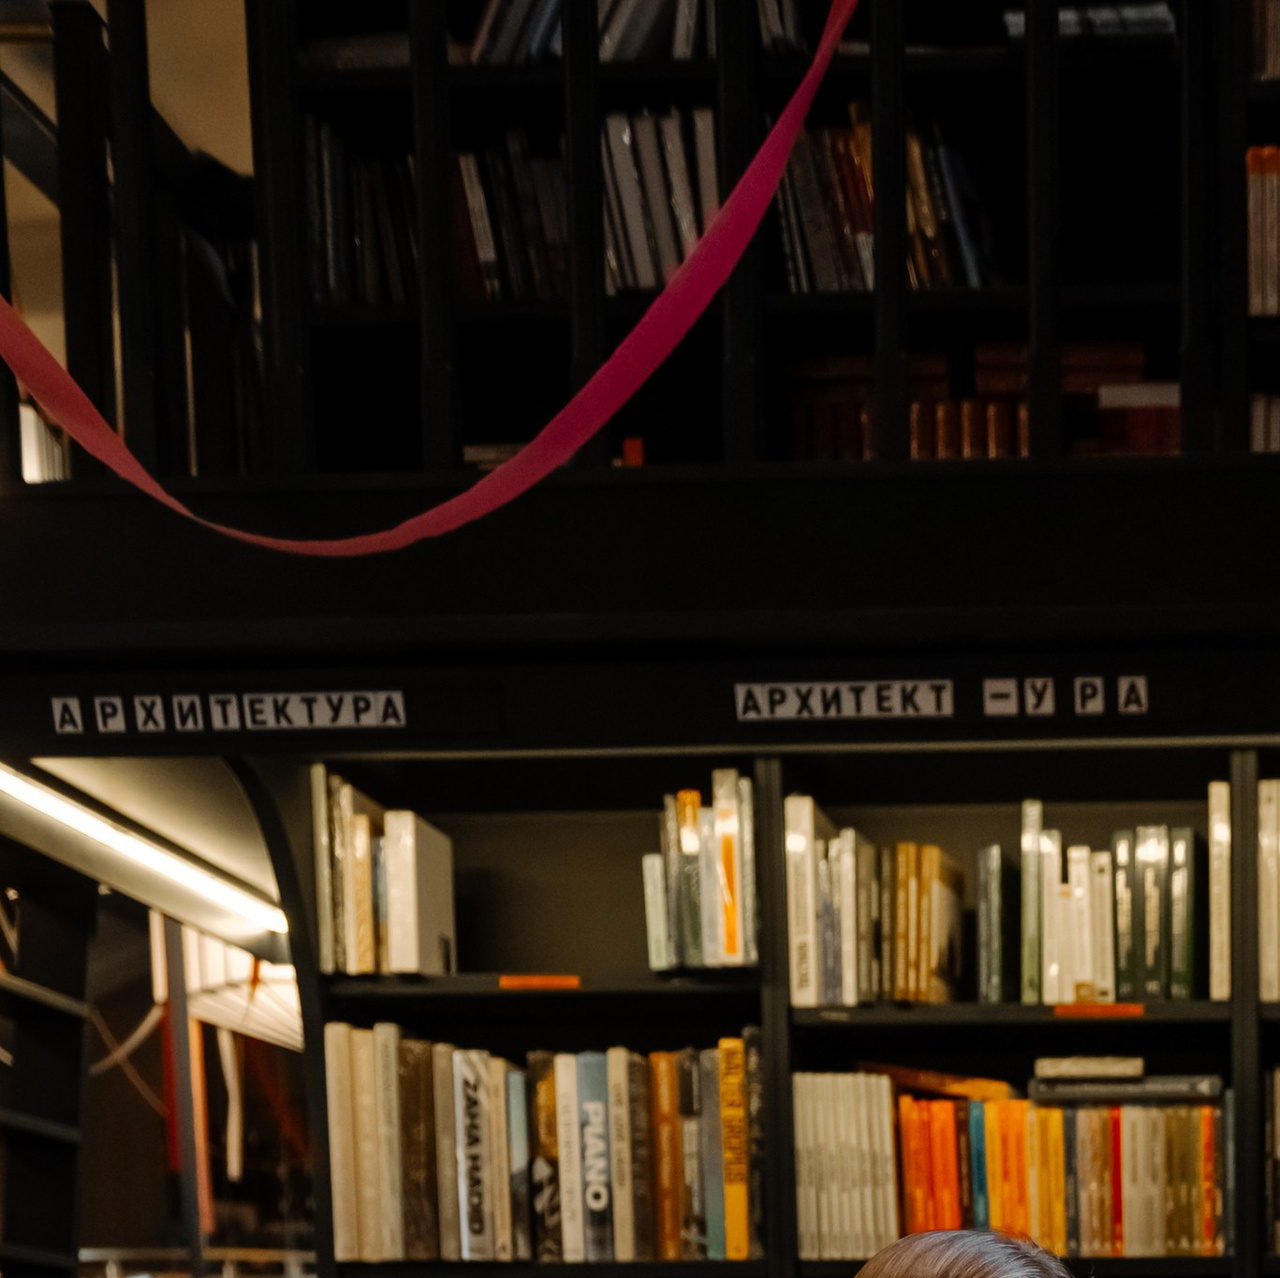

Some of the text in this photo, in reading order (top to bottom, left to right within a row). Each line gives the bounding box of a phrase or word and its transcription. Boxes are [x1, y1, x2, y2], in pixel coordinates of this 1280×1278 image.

[57, 693, 403, 728] АРХИТЕКТУРА
[740, 682, 949, 718] АРХИТЕКТ
[463, 1079, 482, 1148] ZAHA
[582, 1100, 610, 1211] PIANO
